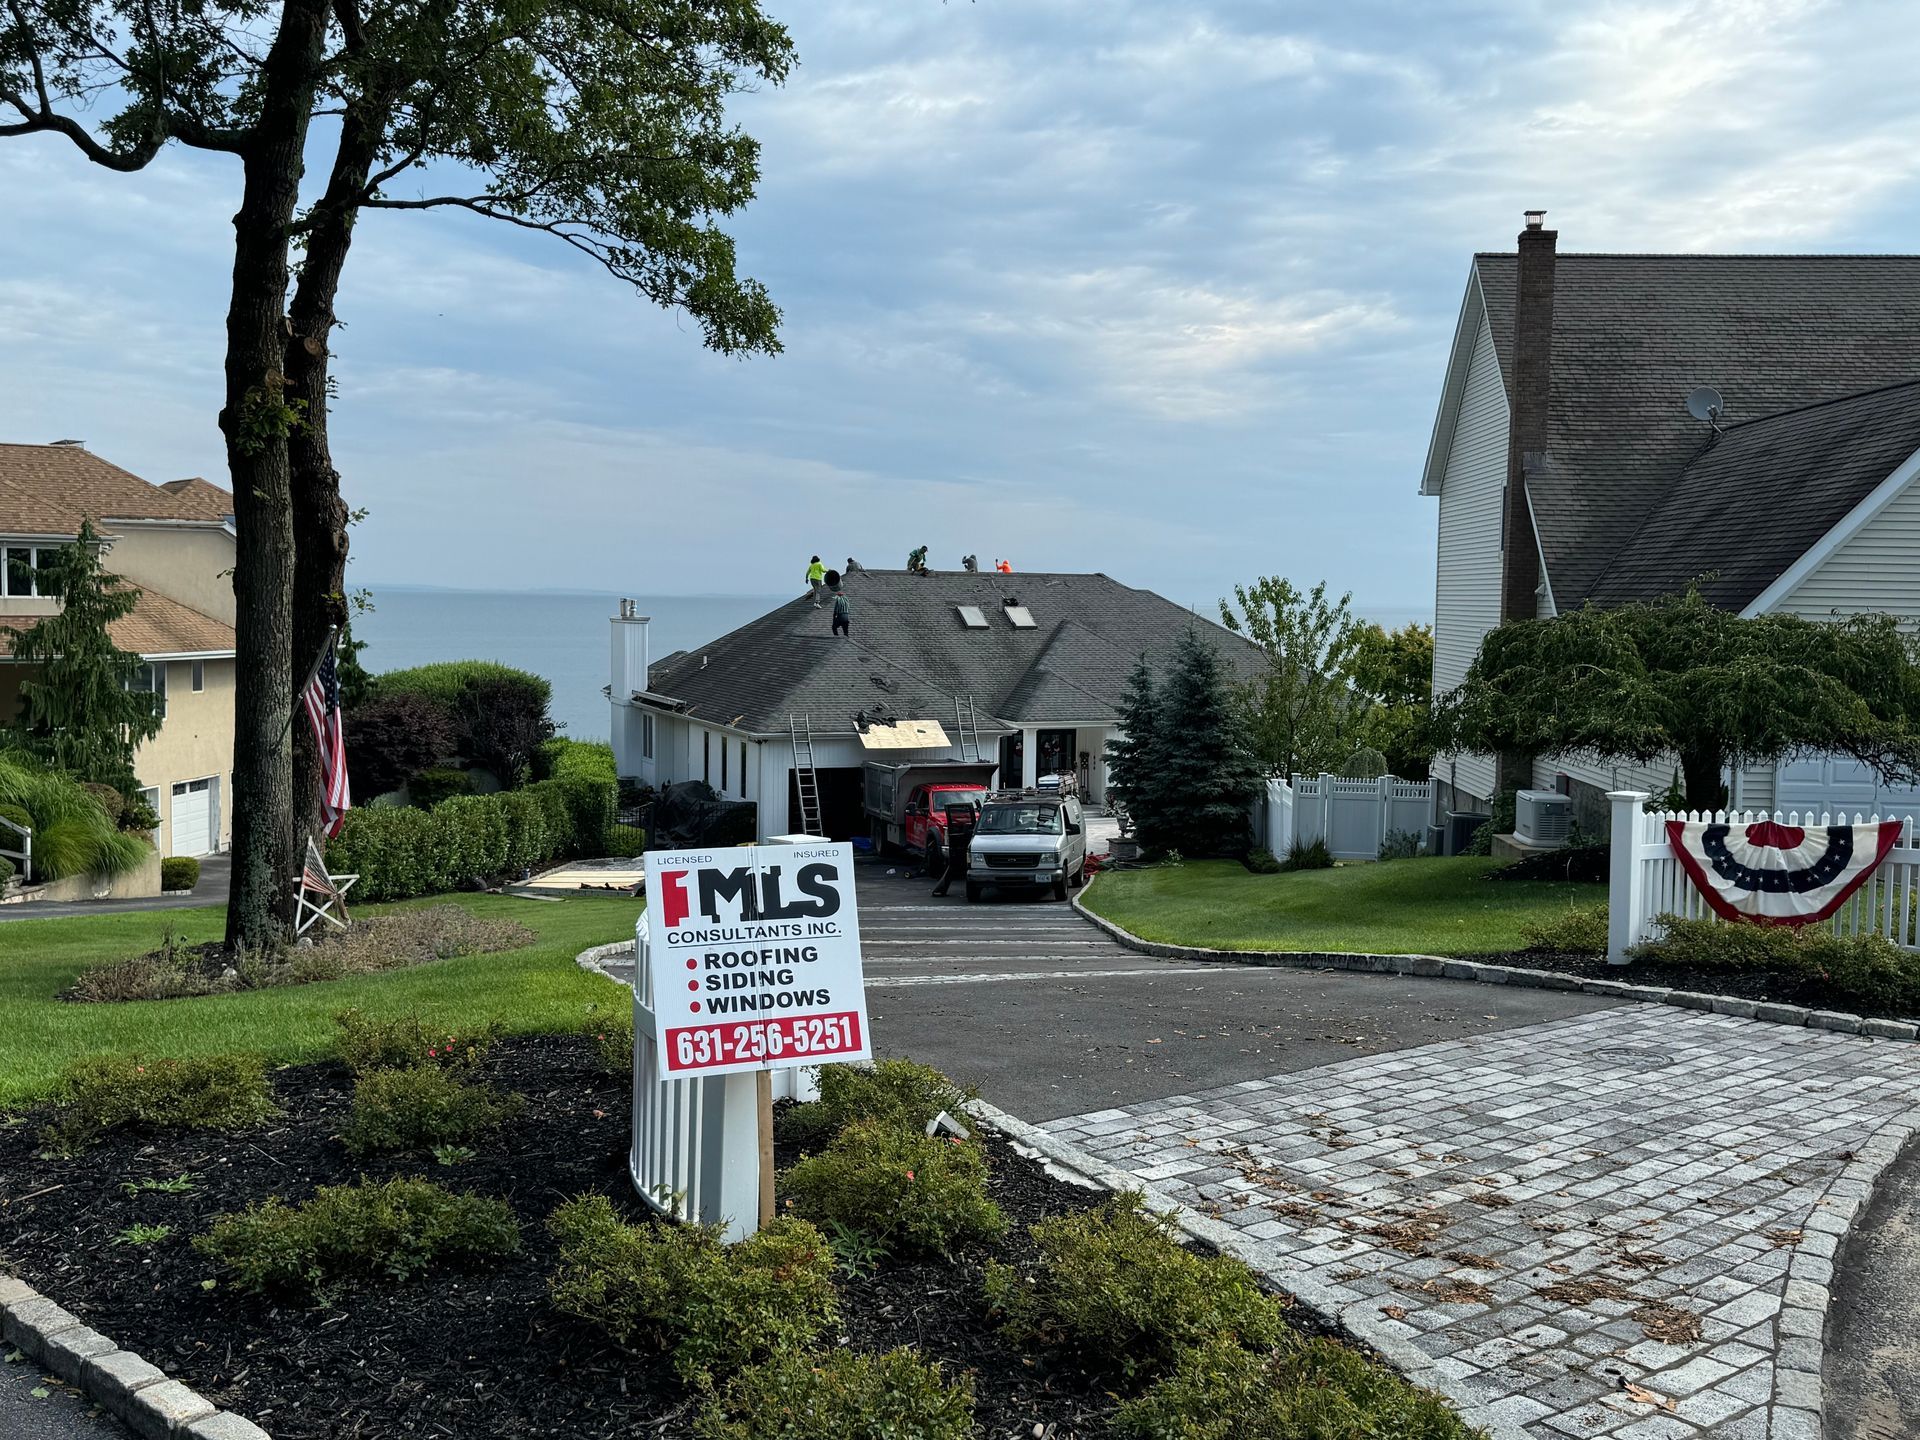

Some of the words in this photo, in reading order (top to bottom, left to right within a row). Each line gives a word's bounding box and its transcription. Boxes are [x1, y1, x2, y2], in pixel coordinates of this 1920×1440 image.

[657, 855, 713, 865] LICENSED
[793, 849, 839, 859] INSURED
[668, 924, 802, 945] CONSULTANTS
[808, 922, 842, 936] INC.
[704, 946, 818, 969] ROOFING
[706, 969, 794, 991] SIDING
[707, 989, 831, 1014] WINDOWS
[676, 1016, 852, 1065] 631-256-5251
